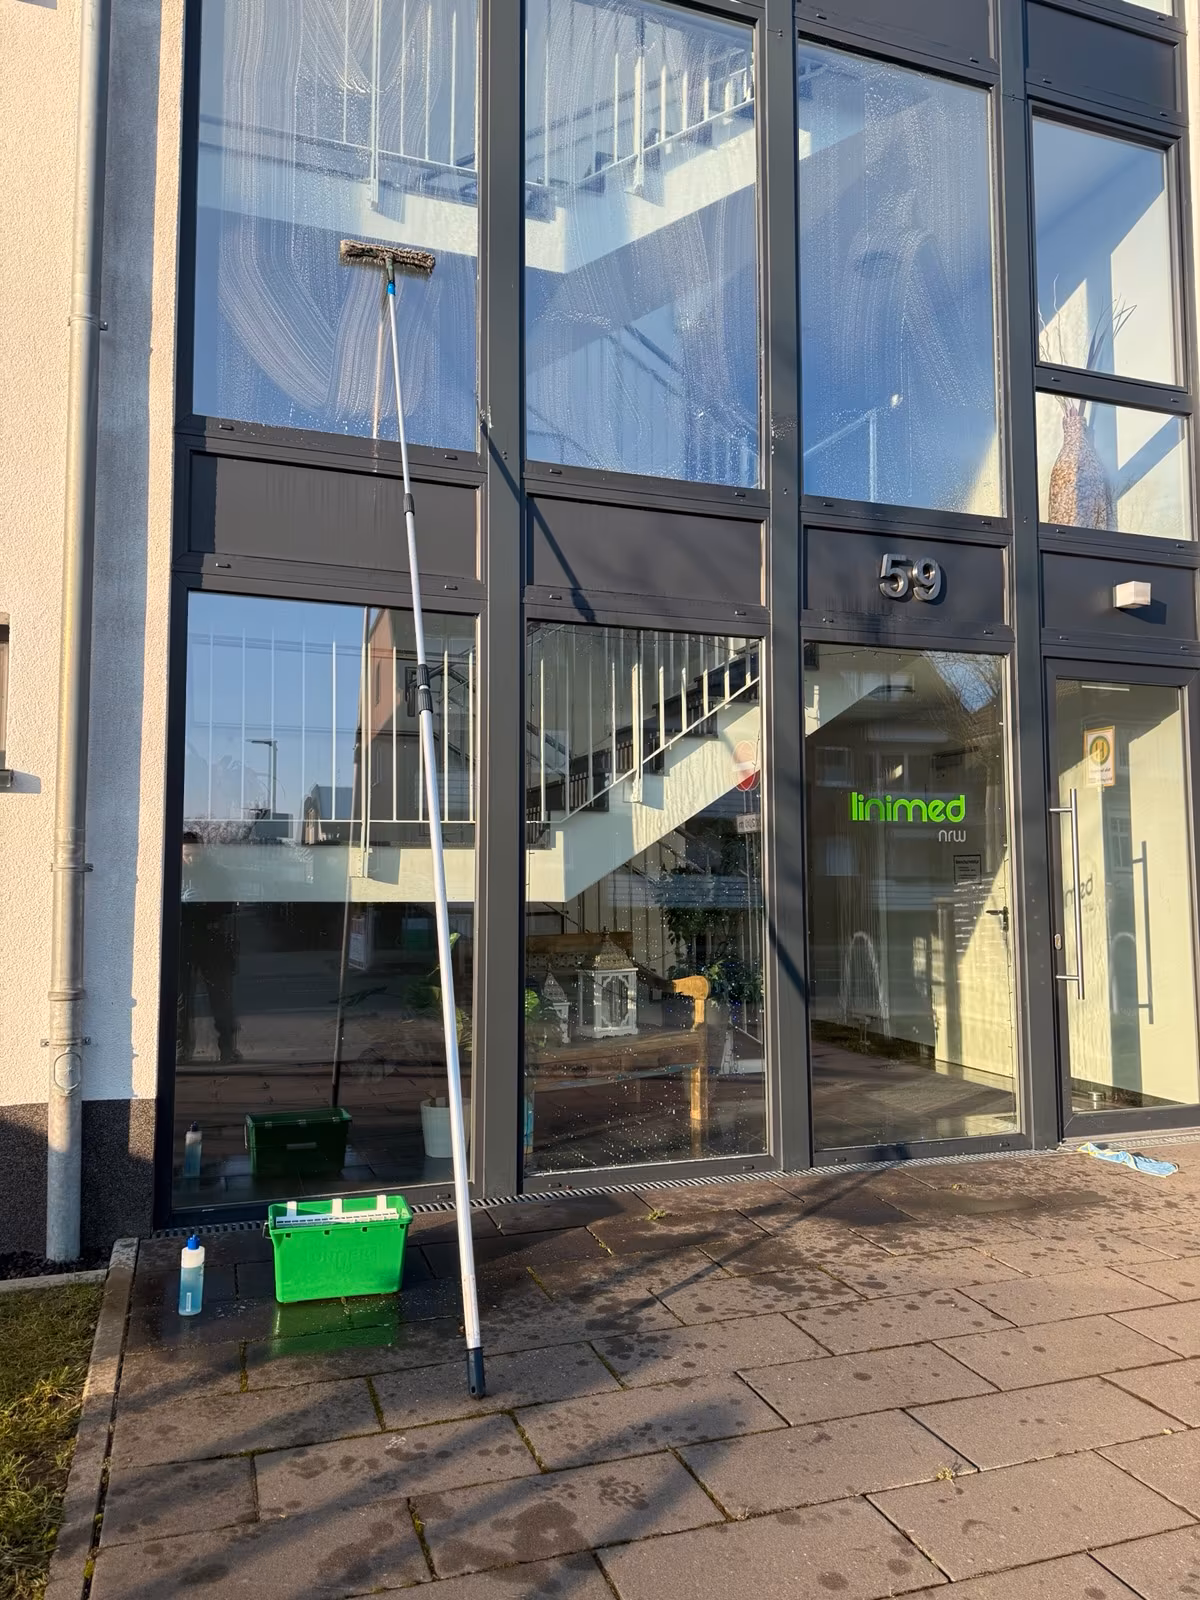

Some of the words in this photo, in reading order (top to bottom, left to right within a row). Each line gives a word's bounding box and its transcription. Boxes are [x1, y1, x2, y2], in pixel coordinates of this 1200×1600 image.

[879, 553, 942, 601] 59
[850, 792, 966, 822] linimed
[938, 829, 966, 842] nrw
